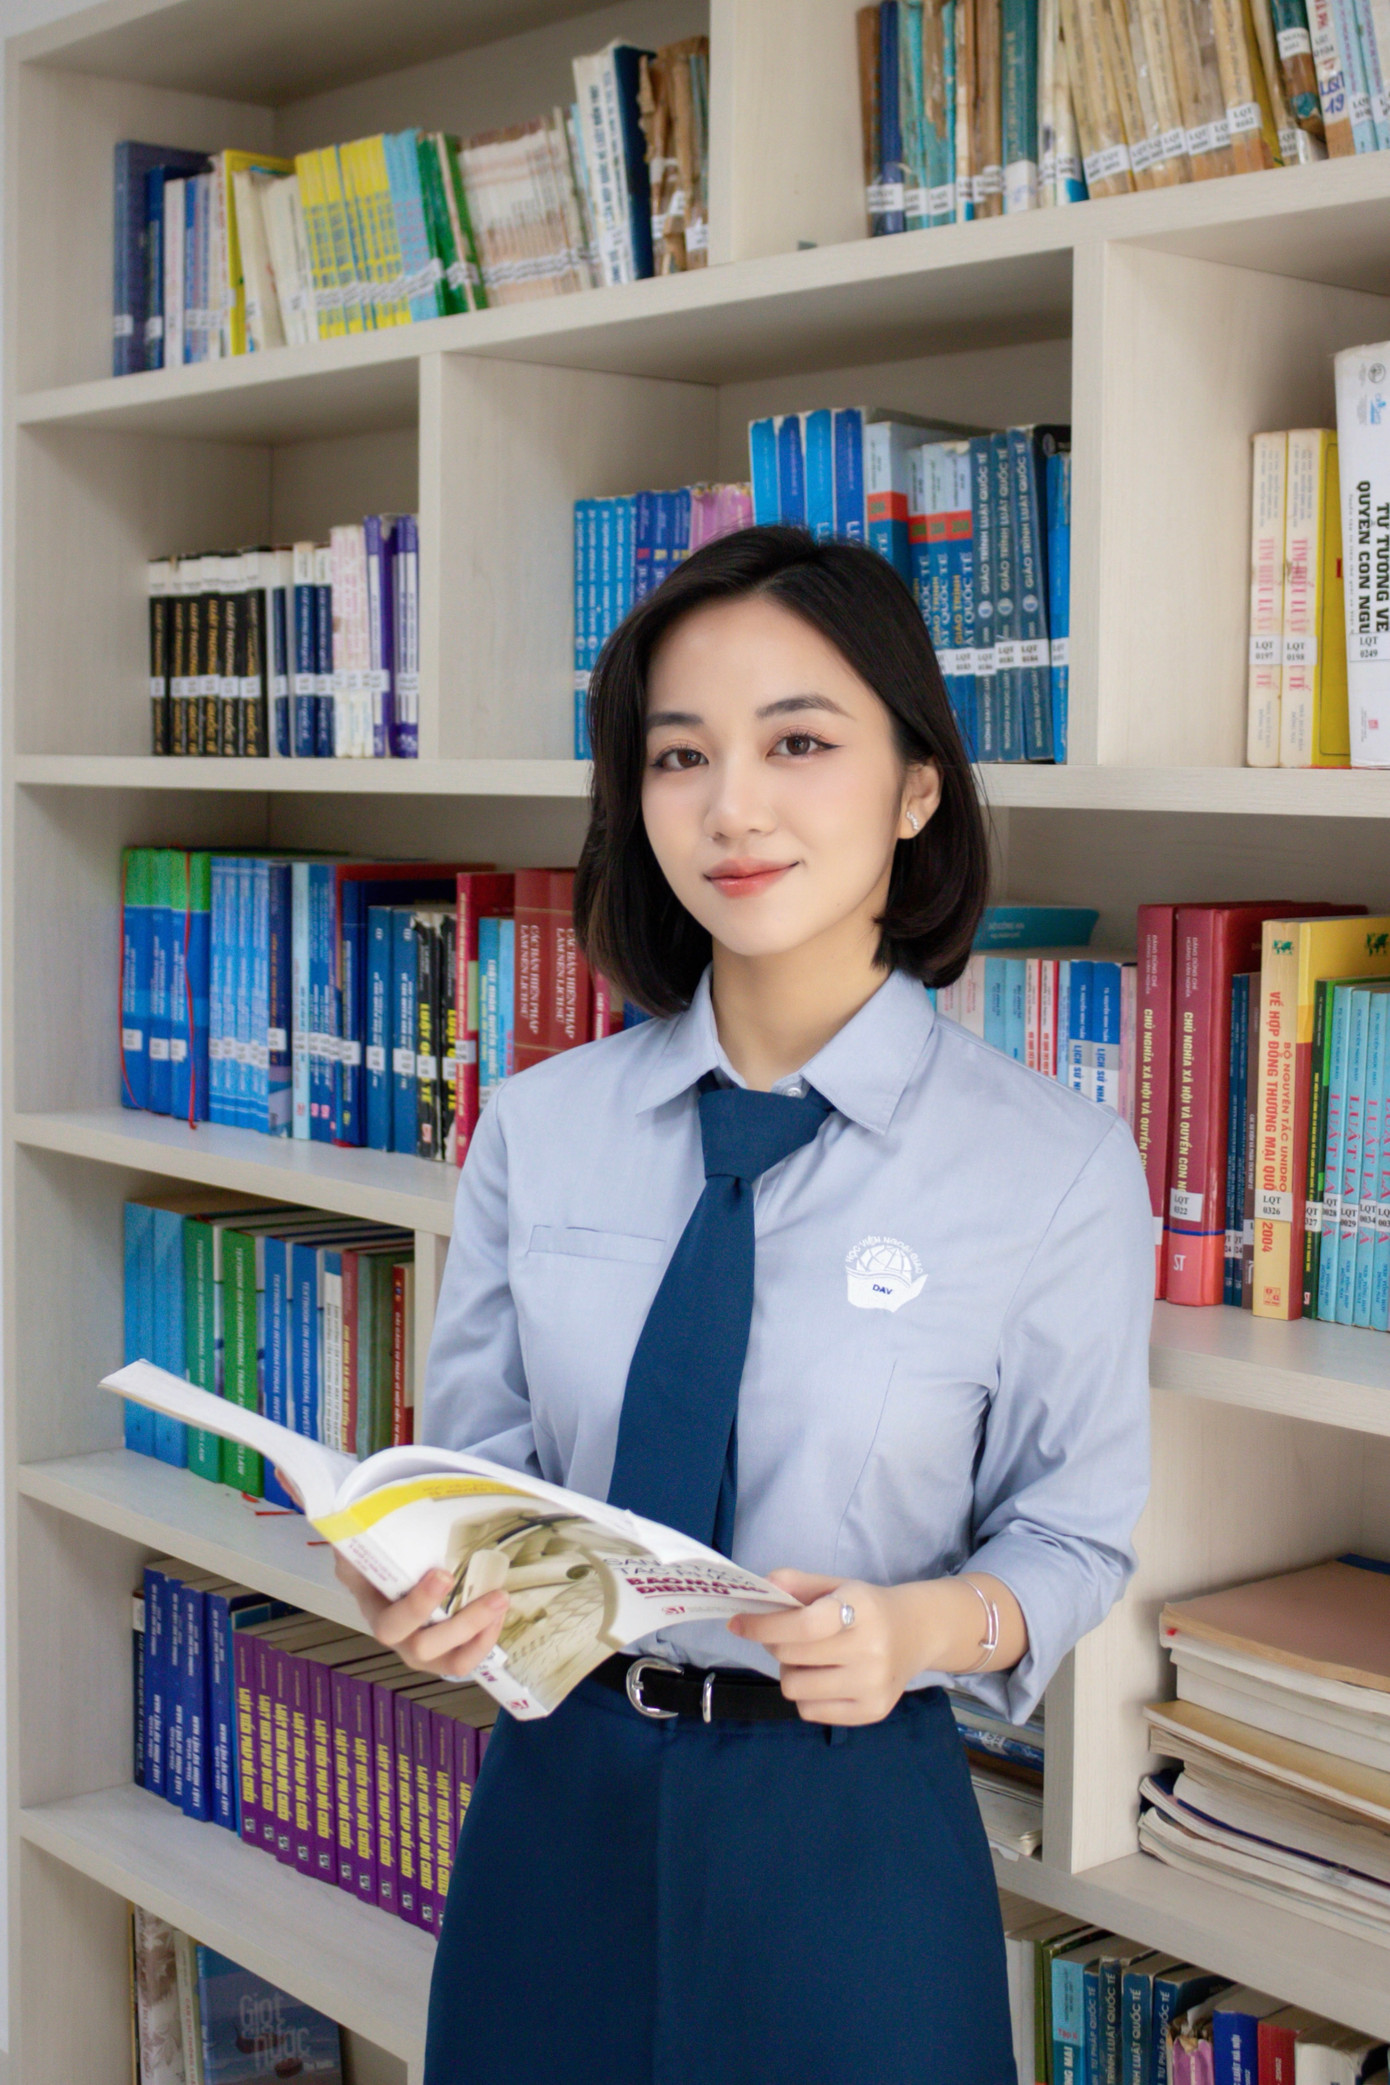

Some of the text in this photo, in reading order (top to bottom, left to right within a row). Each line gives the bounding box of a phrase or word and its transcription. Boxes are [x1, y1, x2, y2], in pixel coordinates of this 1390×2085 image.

[998, 462, 1009, 496] QUỐC
[1016, 456, 1028, 492] QUỐC
[998, 498, 1010, 526] LUẬT
[1019, 494, 1030, 521] LUẬT
[999, 528, 1010, 558] TRÌNH
[1021, 523, 1030, 554] TRÌNH
[1000, 560, 1010, 592] GIÁO
[1022, 556, 1034, 588] GIÁO
[1358, 550, 1371, 587] CON
[962, 577, 975, 623] QUỐC
[954, 614, 962, 644] GIÁO
[1360, 636, 1378, 646] LQT
[1256, 641, 1273, 650] LQT
[1287, 642, 1304, 652] LQT
[1360, 648, 1378, 658] 0249
[420, 1003, 432, 1039] LUẬT
[1074, 1045, 1084, 1079] LỊCH SỬ
[1284, 1042, 1292, 1060] BỘ
[1096, 1048, 1108, 1103] LỊCH SỬ NHÀ
[1140, 1008, 1156, 1151] CHỦ NGHĨA XÃ HỘI VÀ QUYỀN
[1178, 1012, 1196, 1178] CHỦ NGHĨA XÃ HỘI VÀ QUYỀN CON
[1262, 991, 1284, 1191] VỀ HỢP ĐỒNG THƯƠNG MẠI QUỐ
[1280, 1117, 1292, 1142] TẮC
[1327, 1093, 1341, 1157] LUẬT
[1344, 1095, 1360, 1196] LUẬT LA
[1362, 1099, 1379, 1200] LUẬT LA
[1278, 1146, 1288, 1192] UNIDRO
[1325, 1166, 1336, 1193] LA
[1174, 1194, 1189, 1205] LQT
[1263, 1196, 1281, 1204] LQT
[1263, 1206, 1280, 1216] 0326
[1341, 1208, 1356, 1218] LQT
[1360, 1204, 1376, 1214] LQT
[1340, 1219, 1356, 1228] 0029
[1360, 1216, 1376, 1224] 0034
[845, 1245, 861, 1263] HỌC
[859, 1234, 881, 1248] VIỆN
[1262, 1222, 1274, 1252] 2004
[236, 1247, 244, 1288] TEXTBOOK
[301, 1282, 310, 1322] TEXTBOOK
[872, 1284, 893, 1295] DAV
[236, 1302, 245, 1366] INTERNATIONAL
[237, 1369, 245, 1394] TRADE
[302, 1339, 310, 1404] INTERNATIONAL
[237, 1455, 246, 1476] LAW
[238, 1688, 253, 1711] LUẬT
[241, 1735, 255, 1758] PHÁP
[395, 1754, 410, 1778] LUẬT
[400, 1804, 413, 1829] PHÁP
[1160, 1991, 1170, 2002] TẾ
[1086, 1998, 1097, 2029] QUỐC
[1104, 1972, 1117, 2083] TRÌNH LUẬT QUỐC TẾ
[1129, 1988, 1142, 2068] LUẬT QUỐC TẾ
[1089, 2032, 1097, 2057] PHÁP
